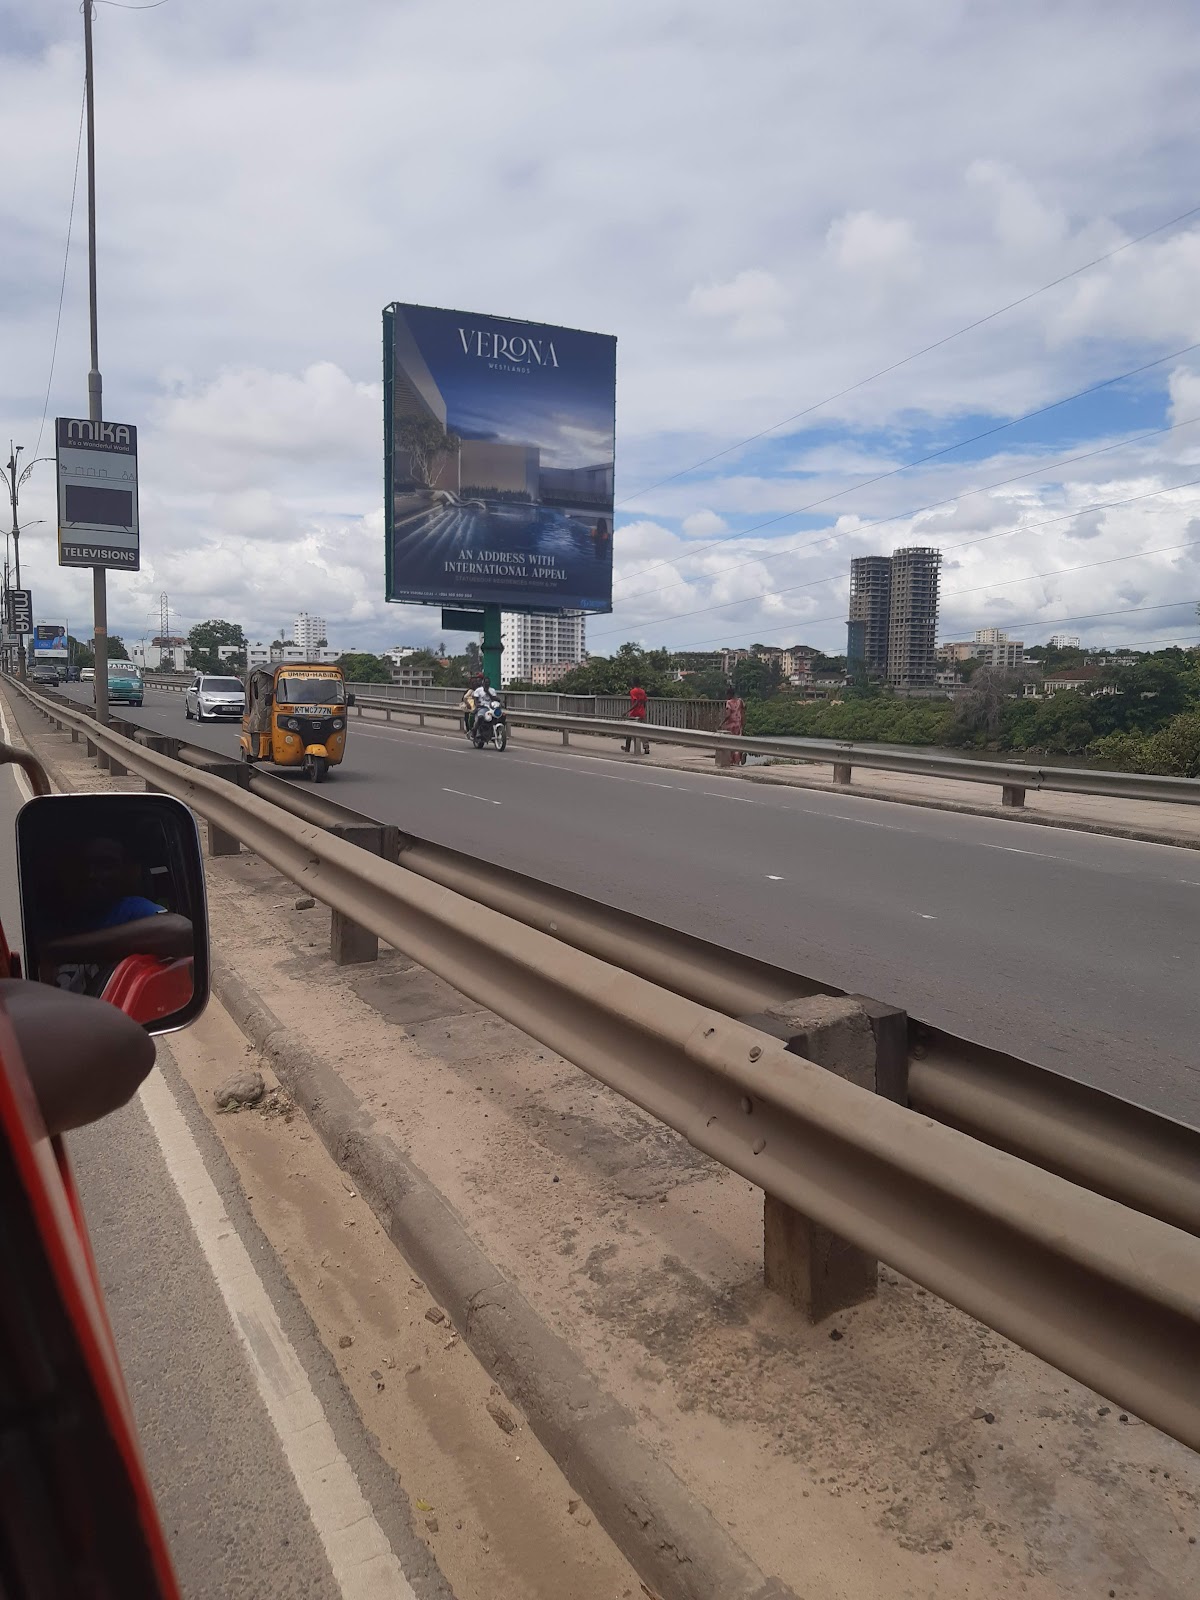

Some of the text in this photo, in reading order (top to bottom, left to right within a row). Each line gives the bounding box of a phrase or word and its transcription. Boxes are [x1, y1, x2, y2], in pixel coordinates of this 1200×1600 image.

[457, 328, 560, 368] VERONA
[488, 362, 530, 374] WESTLANDS
[67, 419, 130, 445] MIKA
[82, 441, 112, 449] Wonderful
[63, 547, 136, 561] TELEVISIONS
[458, 549, 555, 566] AN ADDRESS WITH
[444, 561, 568, 581] INTERNATIONAL APPEAL
[14, 590, 30, 632] MIKA
